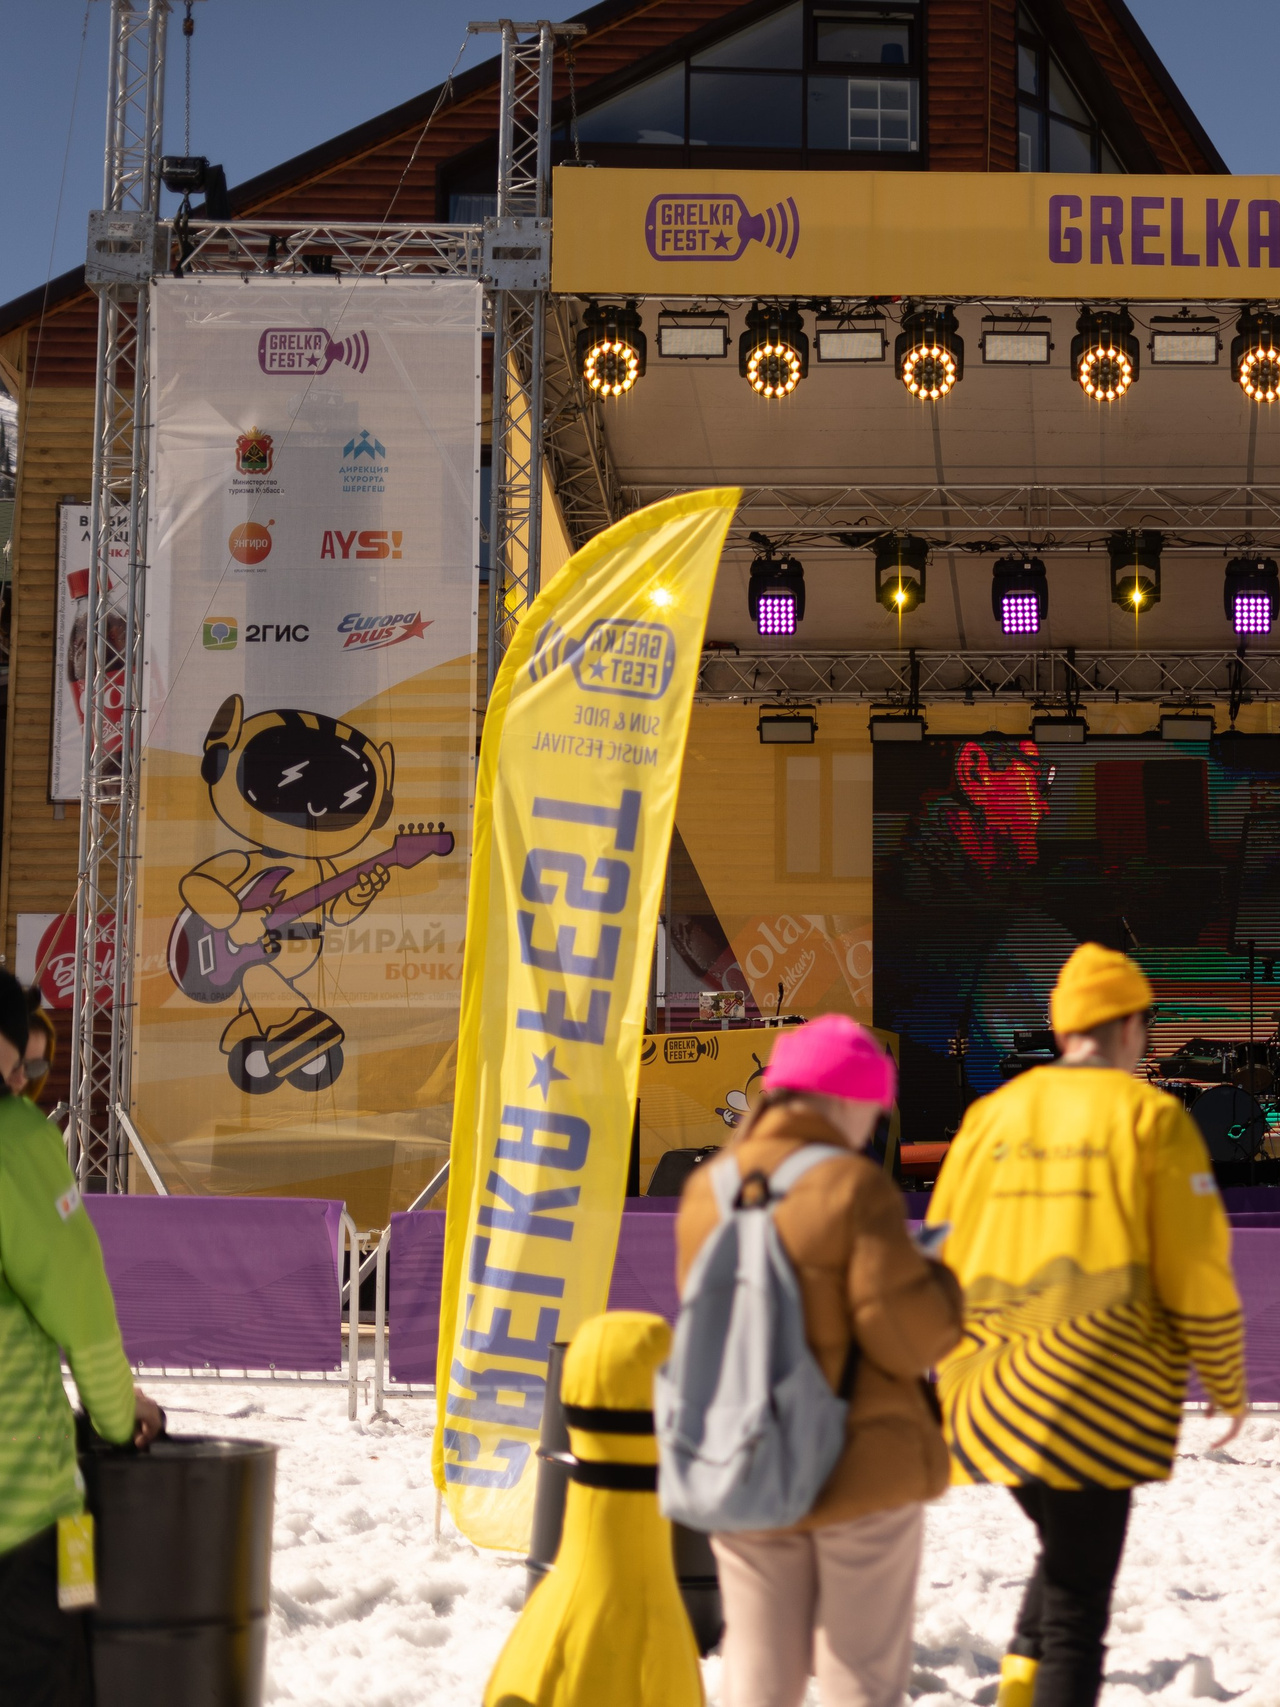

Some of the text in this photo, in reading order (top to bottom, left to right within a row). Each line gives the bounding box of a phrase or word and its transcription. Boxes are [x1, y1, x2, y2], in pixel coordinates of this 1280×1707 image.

[661, 203, 734, 226] GRELKA
[661, 229, 710, 251] FEST
[269, 334, 322, 350] GRELKA
[269, 352, 304, 368] FEST
[339, 466, 389, 474] ДИРЕКЦИЯ
[232, 478, 278, 486] Министерство
[342, 485, 385, 493] ШЕРЕГЕШ
[228, 487, 285, 496] туризма Кузбасса
[233, 538, 268, 550] энгиро
[320, 530, 403, 560] AYS!
[337, 611, 416, 633] Europa
[245, 624, 310, 643] 2ГИС
[669, 1040, 695, 1050] GRELKA
[669, 1050, 687, 1060] FEST
